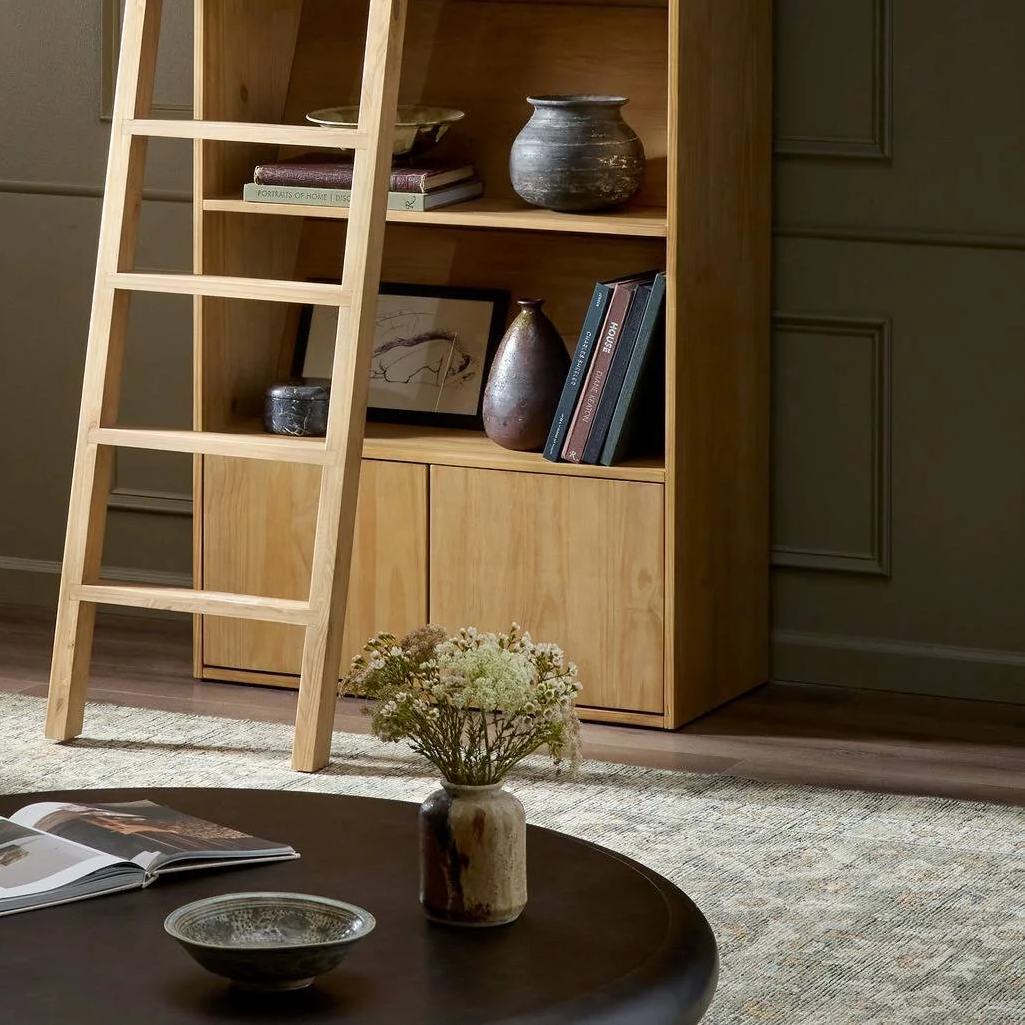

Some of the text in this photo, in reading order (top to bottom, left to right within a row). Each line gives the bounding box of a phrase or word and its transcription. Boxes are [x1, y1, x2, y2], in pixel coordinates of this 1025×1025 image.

[257, 189, 292, 198] PORTRAITS
[294, 191, 304, 199] OF
[306, 192, 327, 201] HOME
[603, 321, 618, 354] HOUSE
[582, 370, 603, 423] DIANE KEATON
